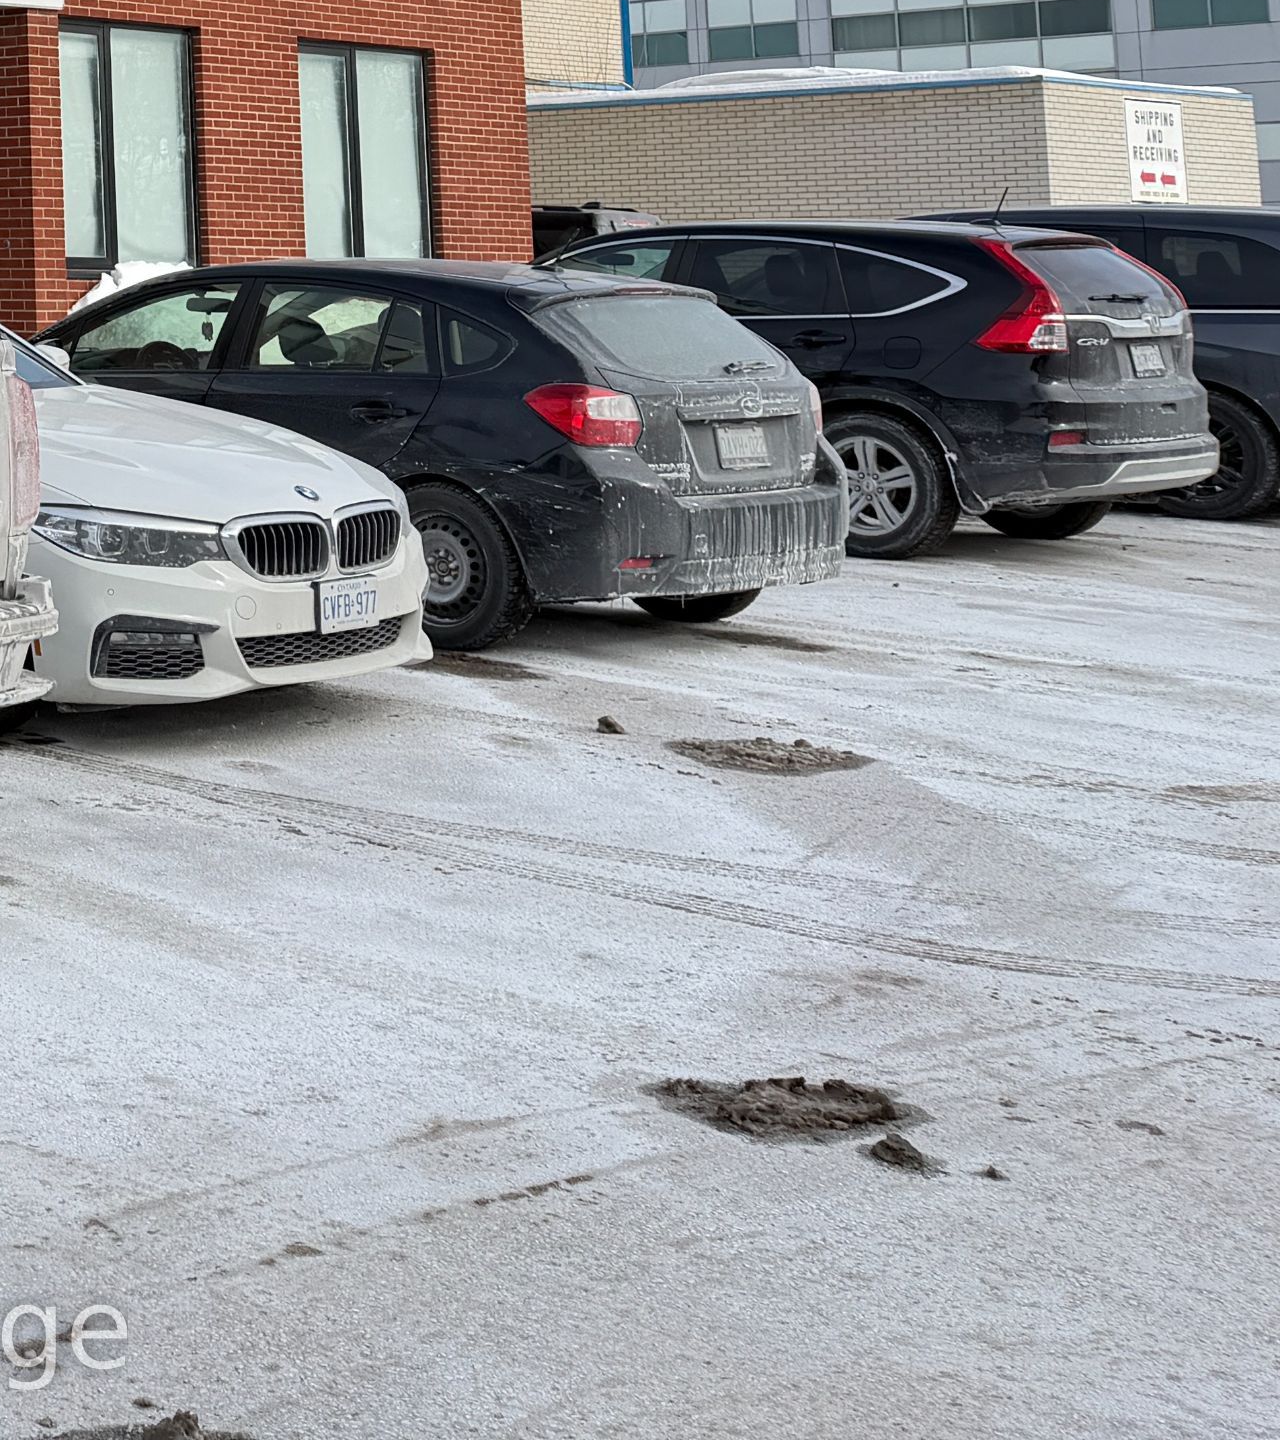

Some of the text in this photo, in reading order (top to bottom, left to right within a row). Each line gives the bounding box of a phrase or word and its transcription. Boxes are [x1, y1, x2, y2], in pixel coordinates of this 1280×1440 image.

[1134, 110, 1175, 127] SHIPPING
[1146, 129, 1164, 144] AND
[1132, 146, 1179, 163] RECEIVING
